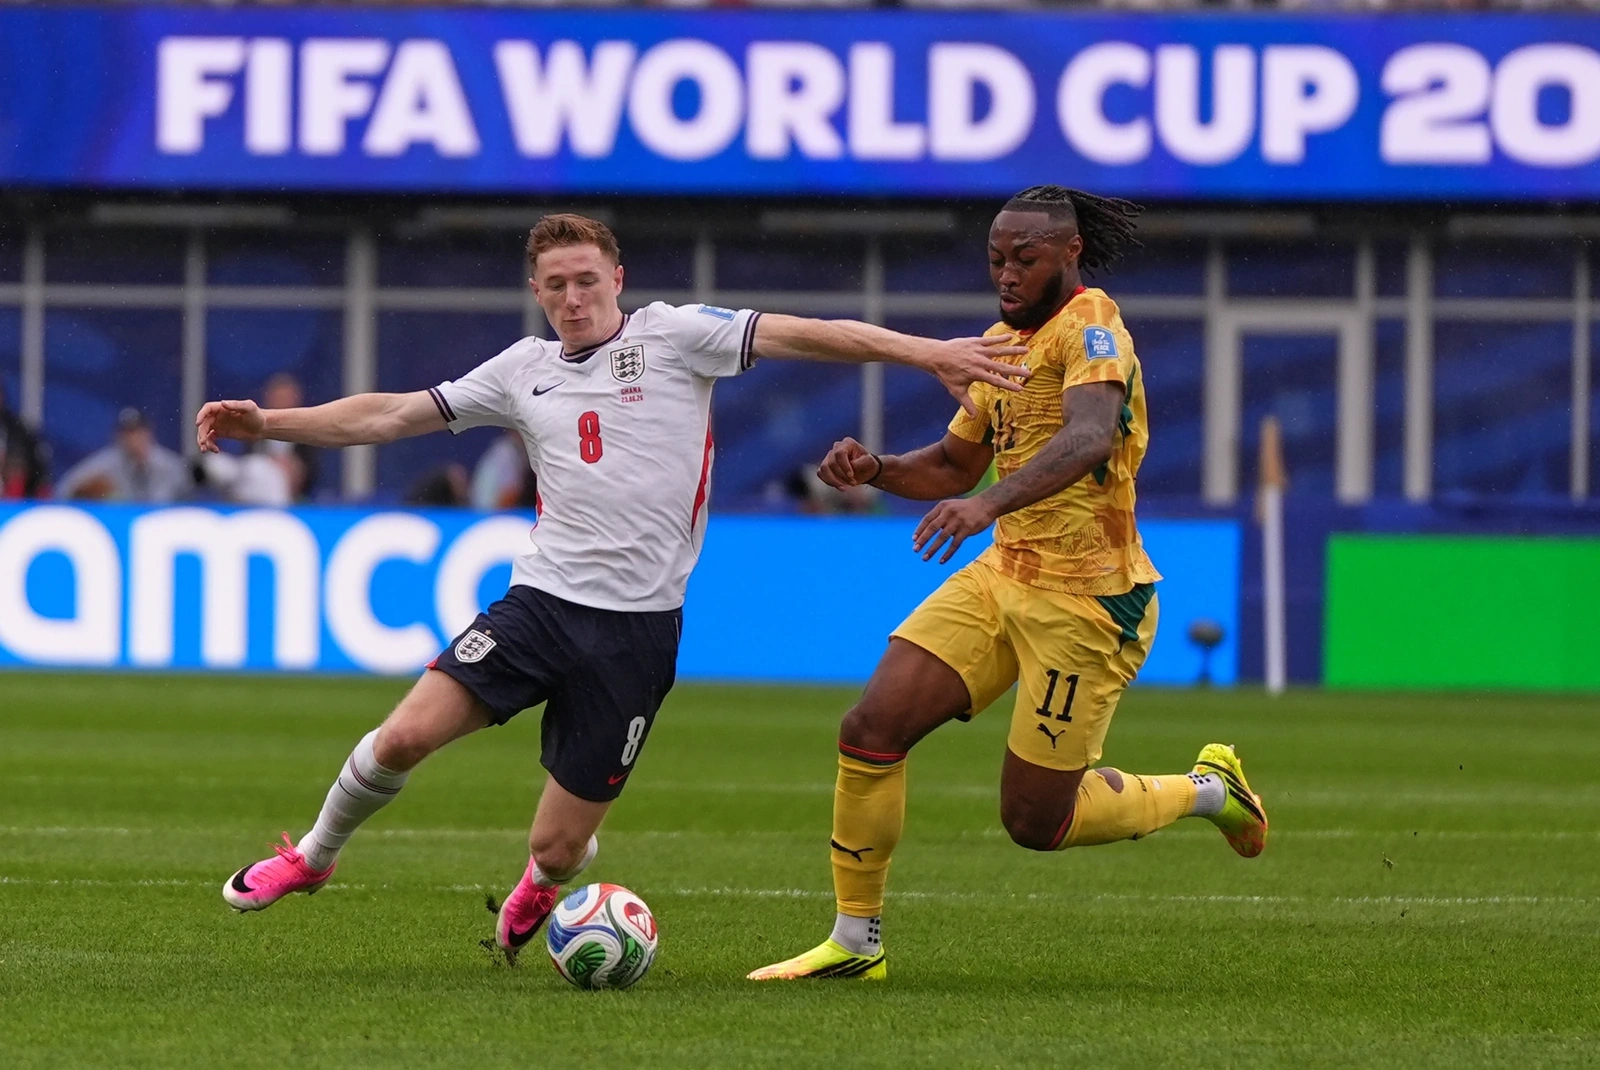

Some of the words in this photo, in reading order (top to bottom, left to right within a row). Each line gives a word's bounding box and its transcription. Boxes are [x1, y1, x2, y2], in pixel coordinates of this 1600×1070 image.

[157, 37, 479, 156] FIFA
[495, 40, 1035, 161] WORLD
[1057, 43, 1358, 165] CUP
[1380, 43, 1600, 168] 20
[620, 386, 642, 396] GHANA
[577, 410, 603, 464] 8
[1035, 668, 1080, 723] 11
[620, 715, 646, 766] 8
